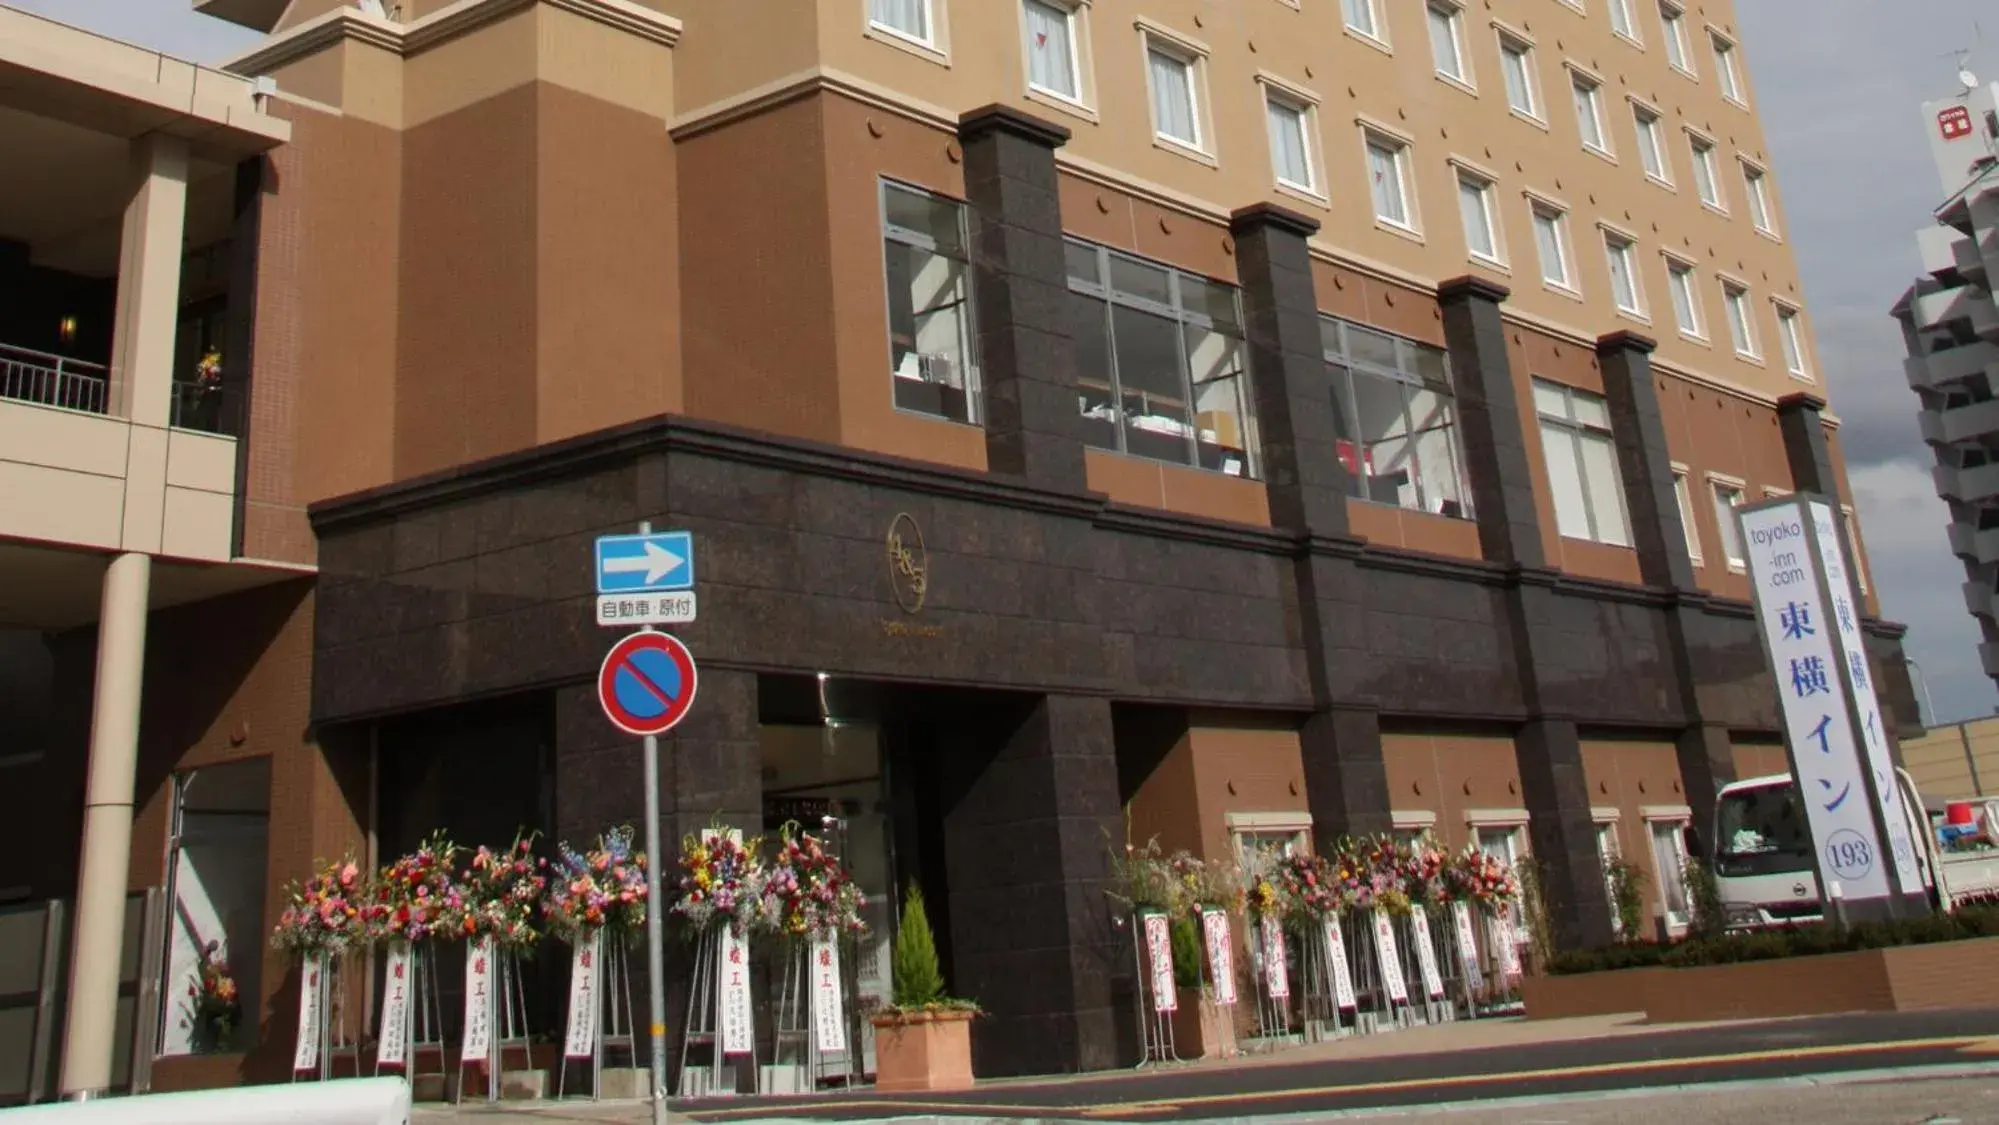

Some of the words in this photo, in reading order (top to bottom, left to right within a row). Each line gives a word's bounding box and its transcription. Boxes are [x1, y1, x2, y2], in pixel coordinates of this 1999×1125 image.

[1751, 522, 1801, 547] toyoko
[1775, 600, 1851, 813] 東横イン
[1835, 595, 1892, 805] 東横イン
[1830, 842, 1871, 870] 193
